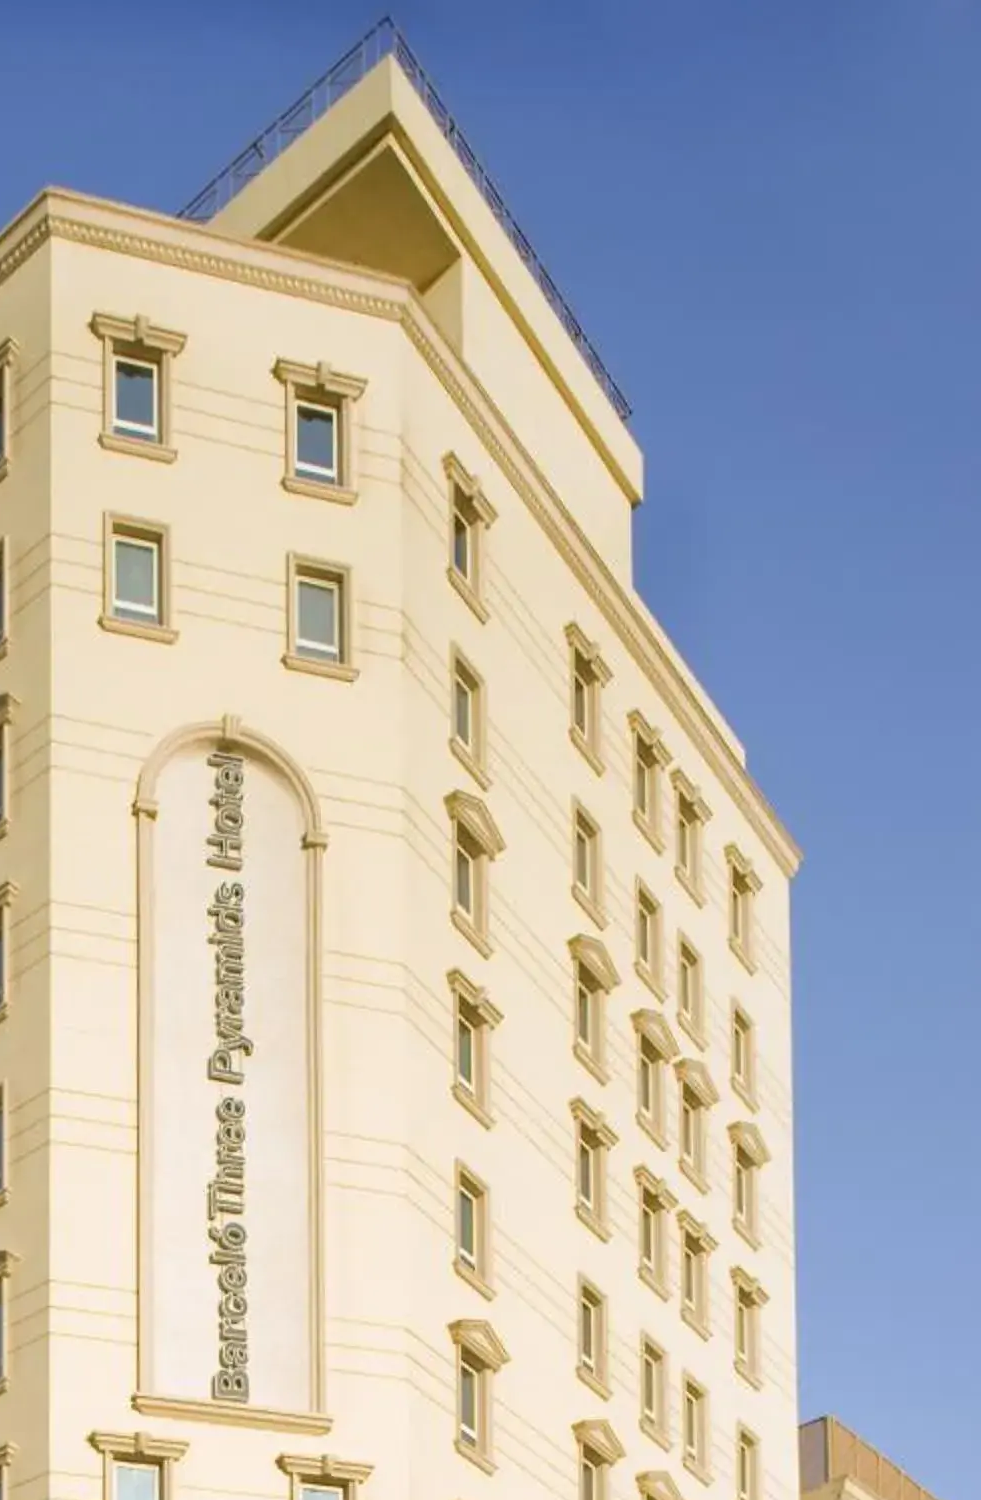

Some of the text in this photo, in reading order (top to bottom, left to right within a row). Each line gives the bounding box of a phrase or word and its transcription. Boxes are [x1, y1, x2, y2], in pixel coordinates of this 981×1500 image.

[206, 753, 254, 1403] Barceló Three Pyramids Hotel
